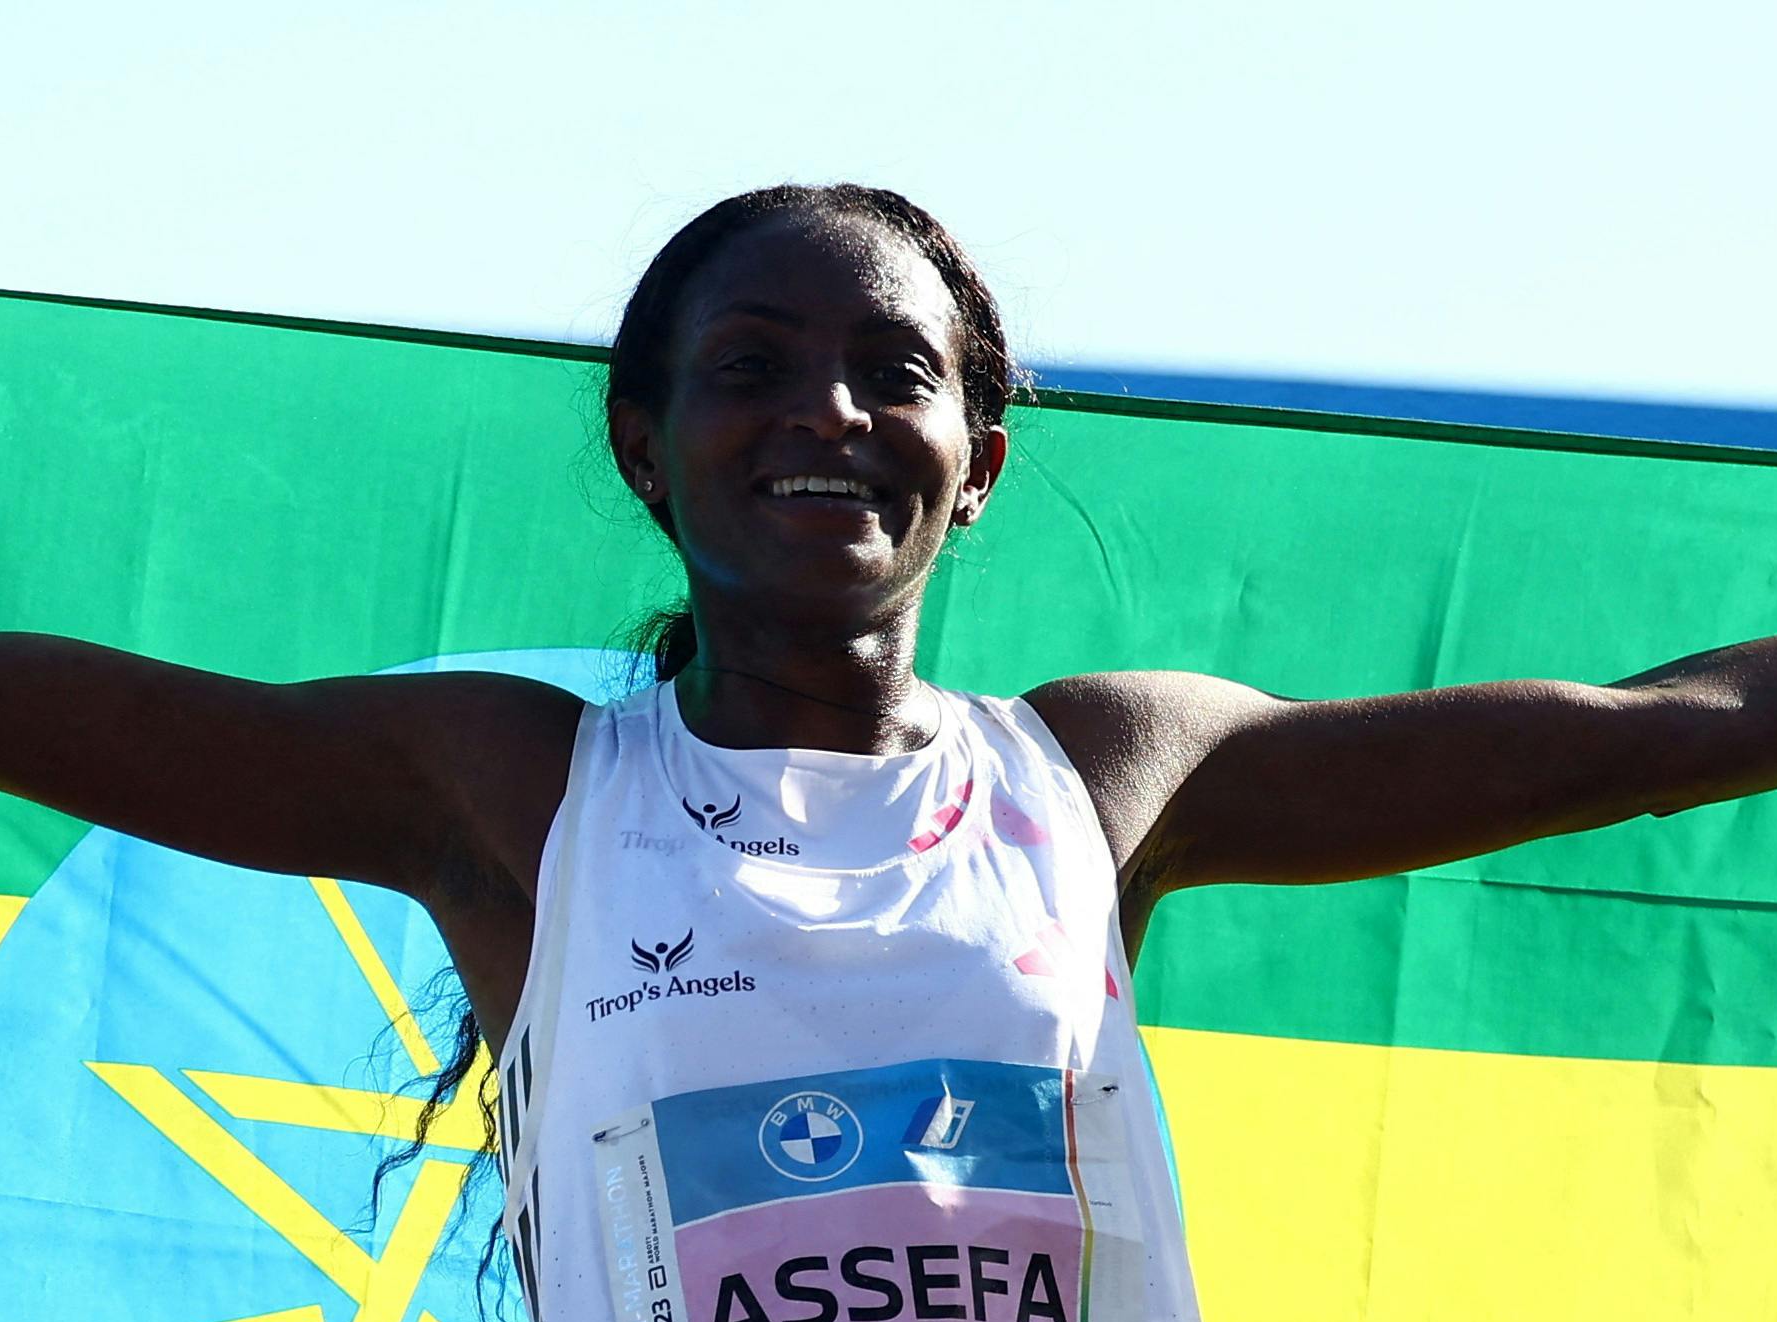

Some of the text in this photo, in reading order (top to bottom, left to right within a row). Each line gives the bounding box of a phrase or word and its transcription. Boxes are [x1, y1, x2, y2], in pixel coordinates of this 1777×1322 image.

[586, 970, 756, 1022] Tirop's Angels
[770, 1096, 845, 1127] BMW
[638, 1154, 650, 1187] MAJORS
[646, 1191, 658, 1234] MARATHON
